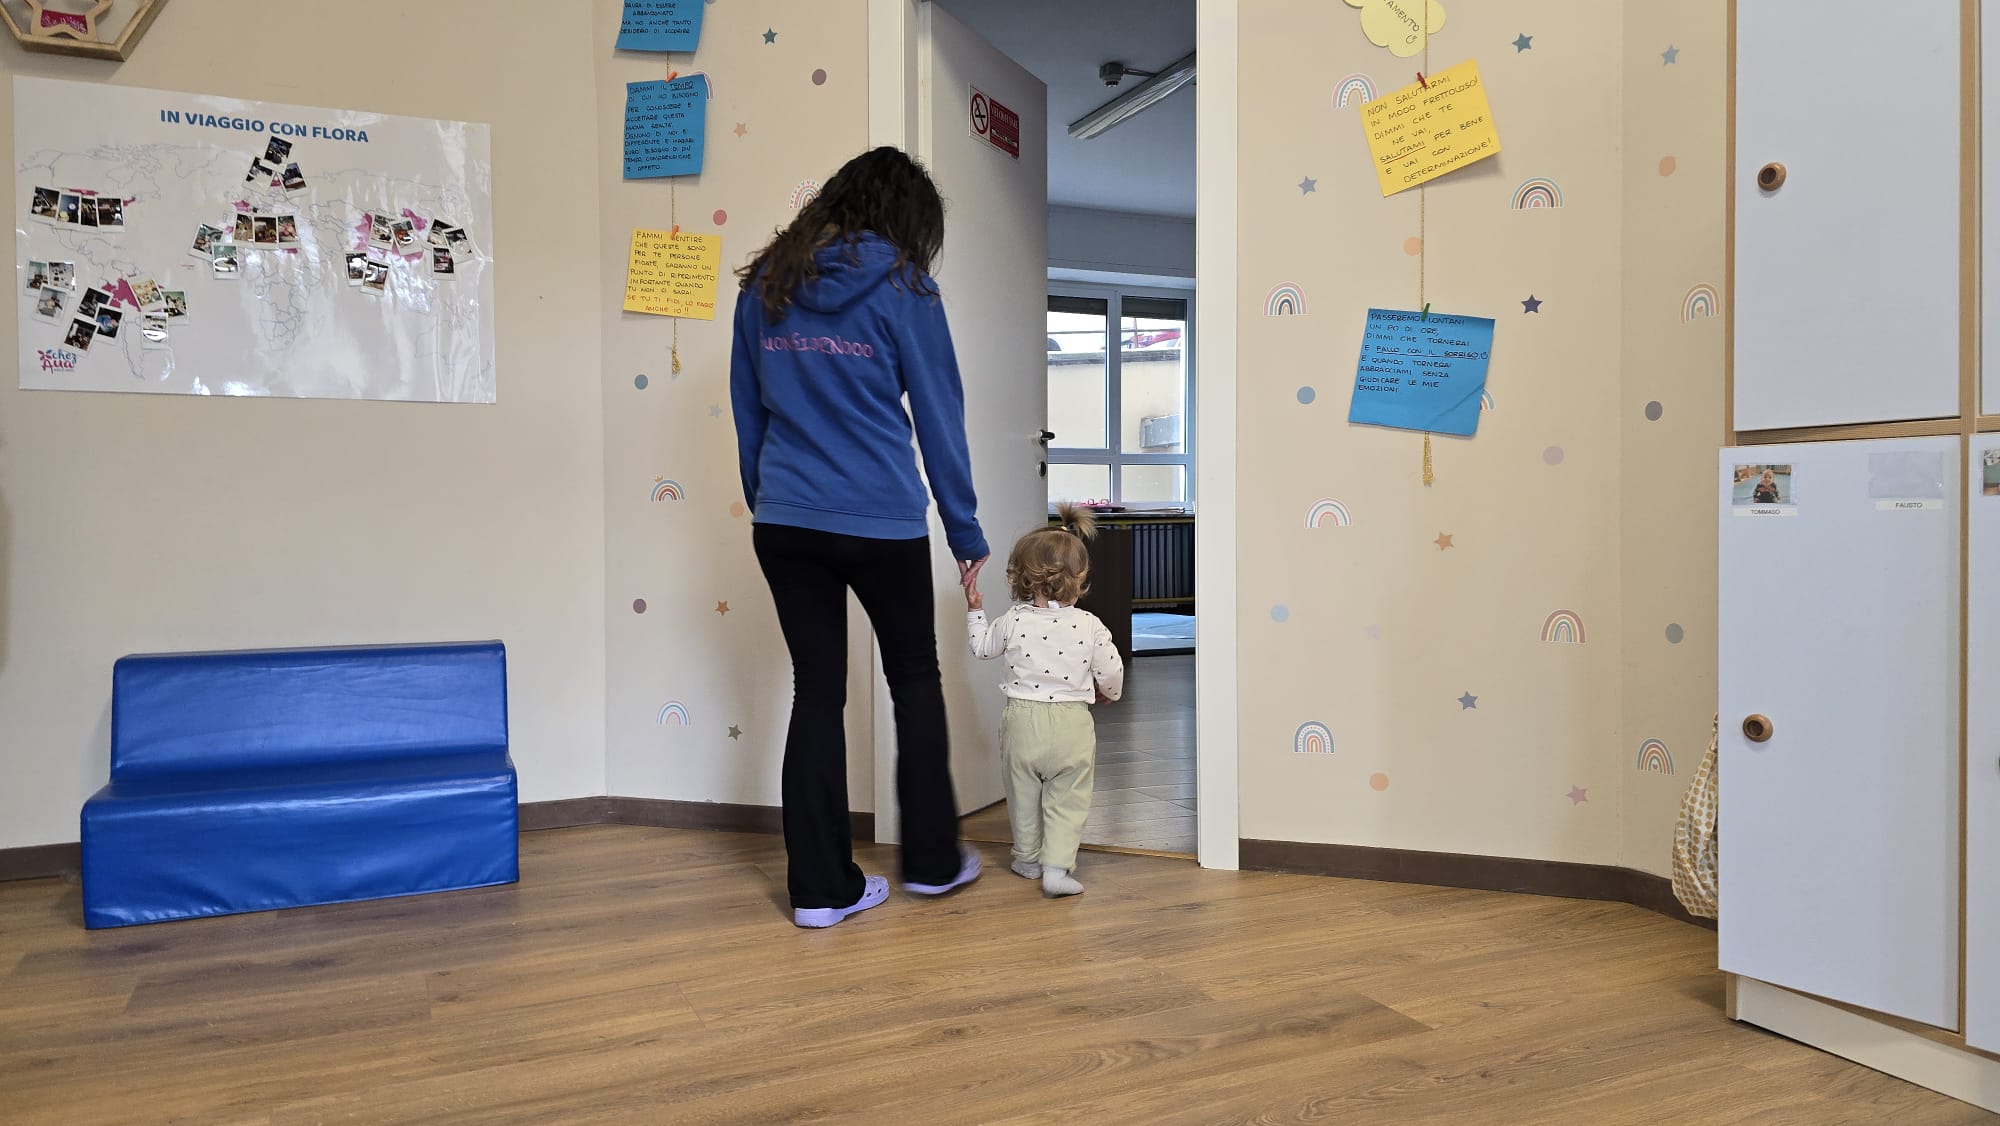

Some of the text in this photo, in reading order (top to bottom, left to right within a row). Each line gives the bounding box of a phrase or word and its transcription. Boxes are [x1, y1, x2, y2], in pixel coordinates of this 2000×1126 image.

[1384, 0, 1420, 32] AMENTO
[630, 85, 655, 94] DAMMI
[670, 81, 694, 91] TEMPO
[1367, 75, 1450, 116] NON SALUTARMI
[646, 103, 681, 111] CONOSCERE
[1371, 119, 1380, 127] IN
[1388, 104, 1416, 120] MODO
[160, 109, 369, 143] IN VIAGGIO CON FLORA
[1374, 104, 1454, 140] DIMMI CHE TE
[1380, 116, 1483, 163] SALUTAMI PER BENE
[1392, 136, 1405, 146] NE
[1402, 158, 1418, 168] VAI
[1432, 145, 1451, 157] CON
[636, 231, 663, 240] FAMMI
[669, 253, 700, 261] PERSONE
[671, 272, 715, 281] RIFERIMENTO
[1371, 313, 1465, 325] PASSEREMO LONTANI
[1366, 332, 1393, 341] DIMMI
[1428, 337, 1470, 347] TORNERAI
[1376, 345, 1400, 354] FALLO
[1372, 357, 1403, 366] QUANDO
[1412, 360, 1452, 368] TORNERAI
[1360, 365, 1412, 376] ABBRACCIAMI
[1358, 385, 1398, 393] EMOZIONI
